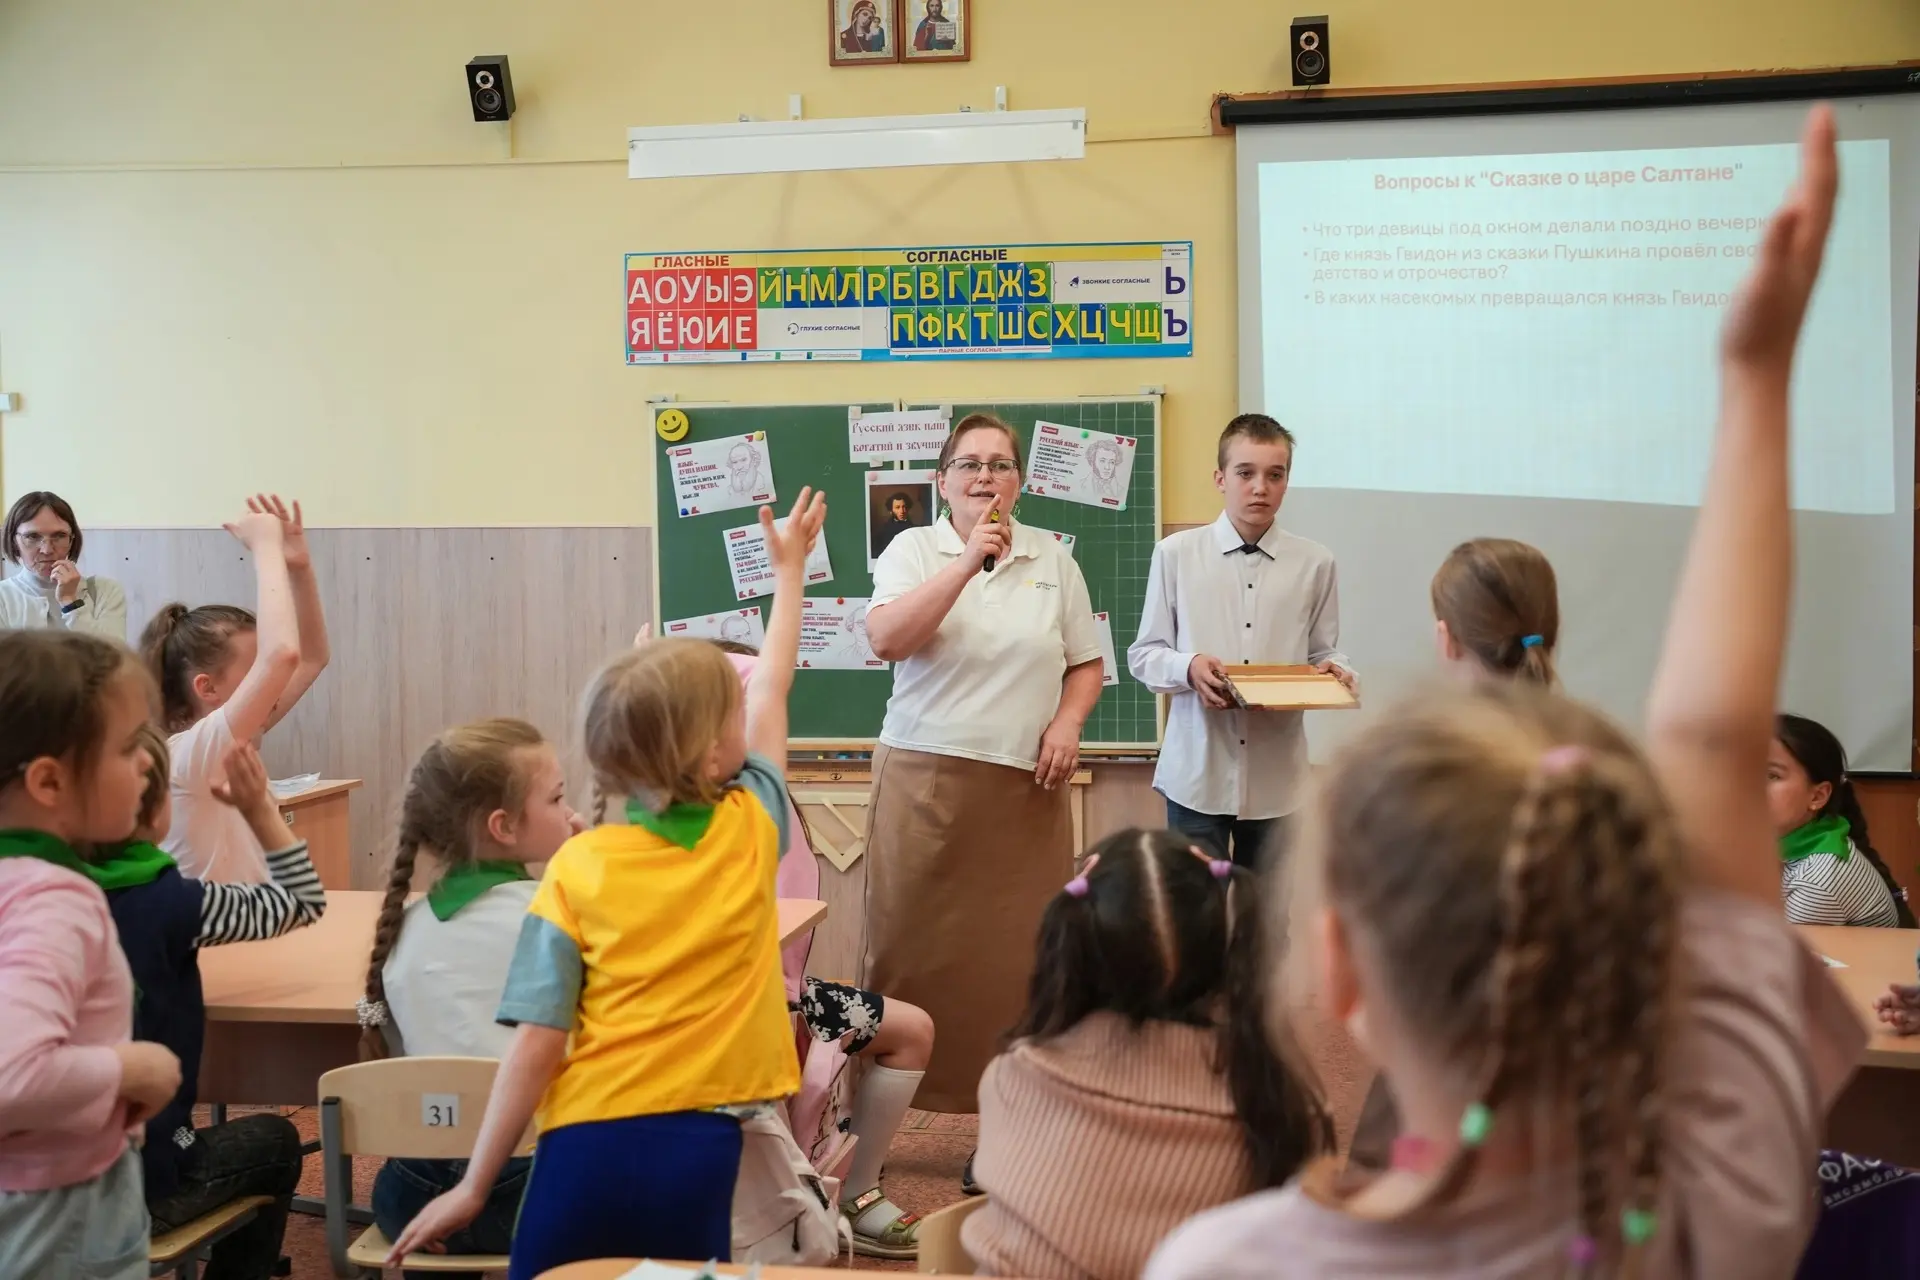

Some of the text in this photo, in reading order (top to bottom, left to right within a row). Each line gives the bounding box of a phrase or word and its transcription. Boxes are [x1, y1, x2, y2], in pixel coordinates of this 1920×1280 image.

[1374, 174, 1459, 192] Вопросы
[1464, 174, 1475, 187] к
[1568, 173, 1579, 185] о
[1585, 168, 1636, 187] царе
[1313, 216, 1767, 240] Что три девицы под окном делали поздно вечерк
[654, 256, 729, 267] ГЛАСНЫЕ
[907, 249, 1007, 262] СОГЛАСНЫЕ
[1313, 248, 1340, 263] Где
[1345, 248, 1392, 261] князь
[1397, 246, 1457, 262] Гвидон
[1462, 248, 1482, 260] из
[1487, 246, 1548, 260] сказки
[1554, 243, 1641, 262] Пушкина
[1722, 245, 1756, 257] сво
[1313, 264, 1508, 282] детство и отрочество?
[1315, 289, 1729, 307] В каких насекомых превращался князь Гвидо
[852, 423, 894, 436] Русский
[428, 1104, 456, 1127] 31
